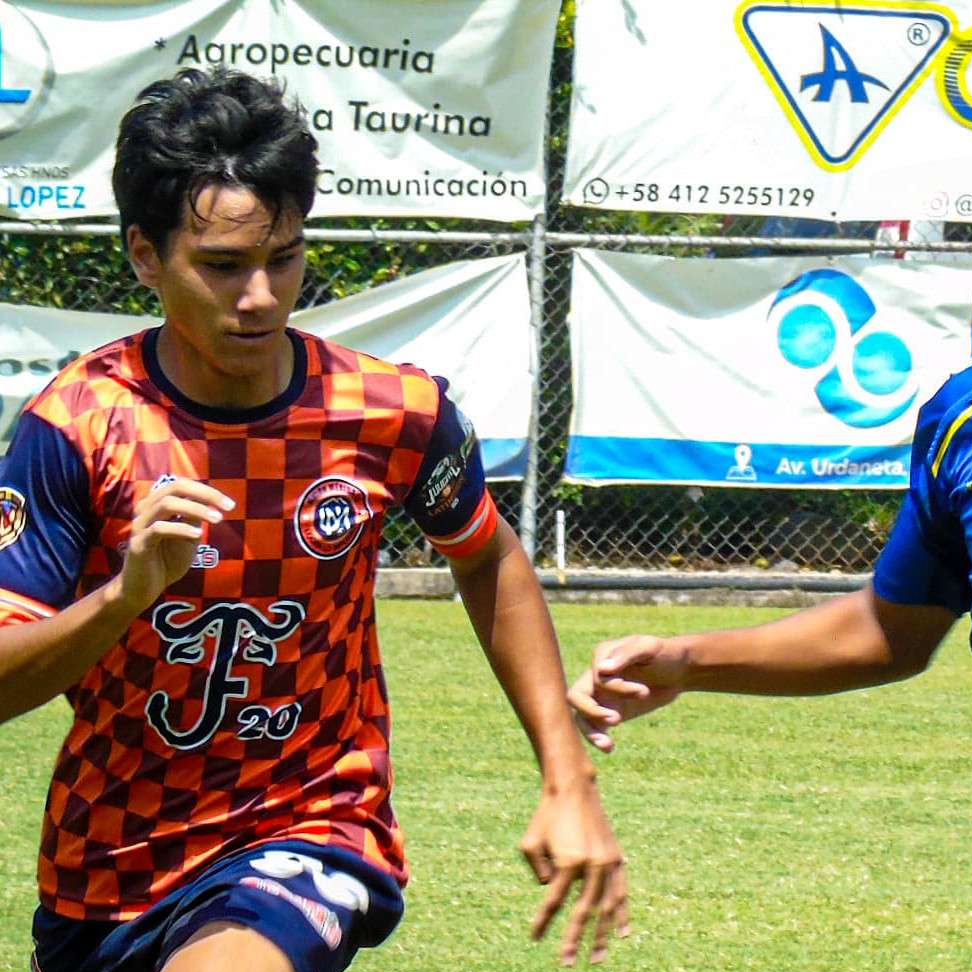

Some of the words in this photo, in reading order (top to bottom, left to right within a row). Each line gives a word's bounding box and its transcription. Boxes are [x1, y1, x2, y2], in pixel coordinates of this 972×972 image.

[177, 34, 435, 74] Agropecuaria
[348, 99, 491, 138] Taurina
[8, 185, 86, 209] LOPEZ
[316, 169, 527, 198] Comunicación
[614, 184, 660, 203] +58
[668, 185, 707, 205] 412
[719, 186, 815, 208] 5255129
[776, 457, 806, 475] Av.
[237, 703, 302, 740] 20
